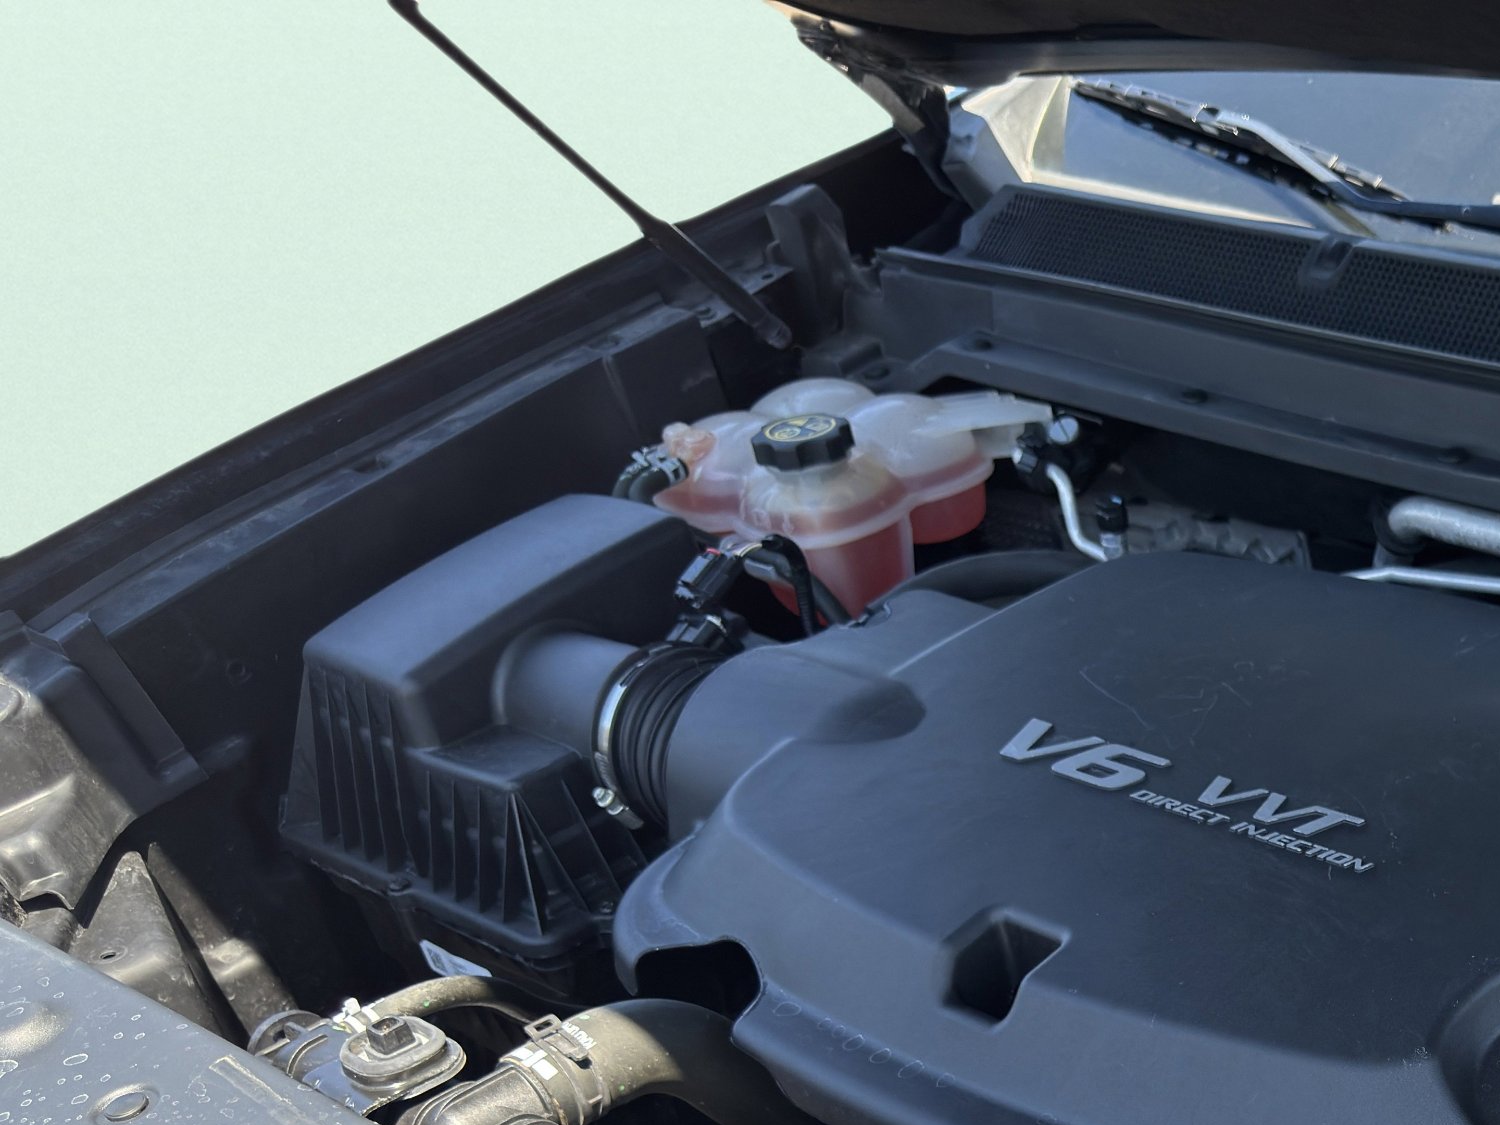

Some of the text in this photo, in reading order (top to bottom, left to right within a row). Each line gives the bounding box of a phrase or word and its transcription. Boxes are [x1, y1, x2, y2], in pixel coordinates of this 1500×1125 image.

[1000, 718, 1366, 836] V6 VVT
[1129, 789, 1375, 873] DIRECT INJECTION
